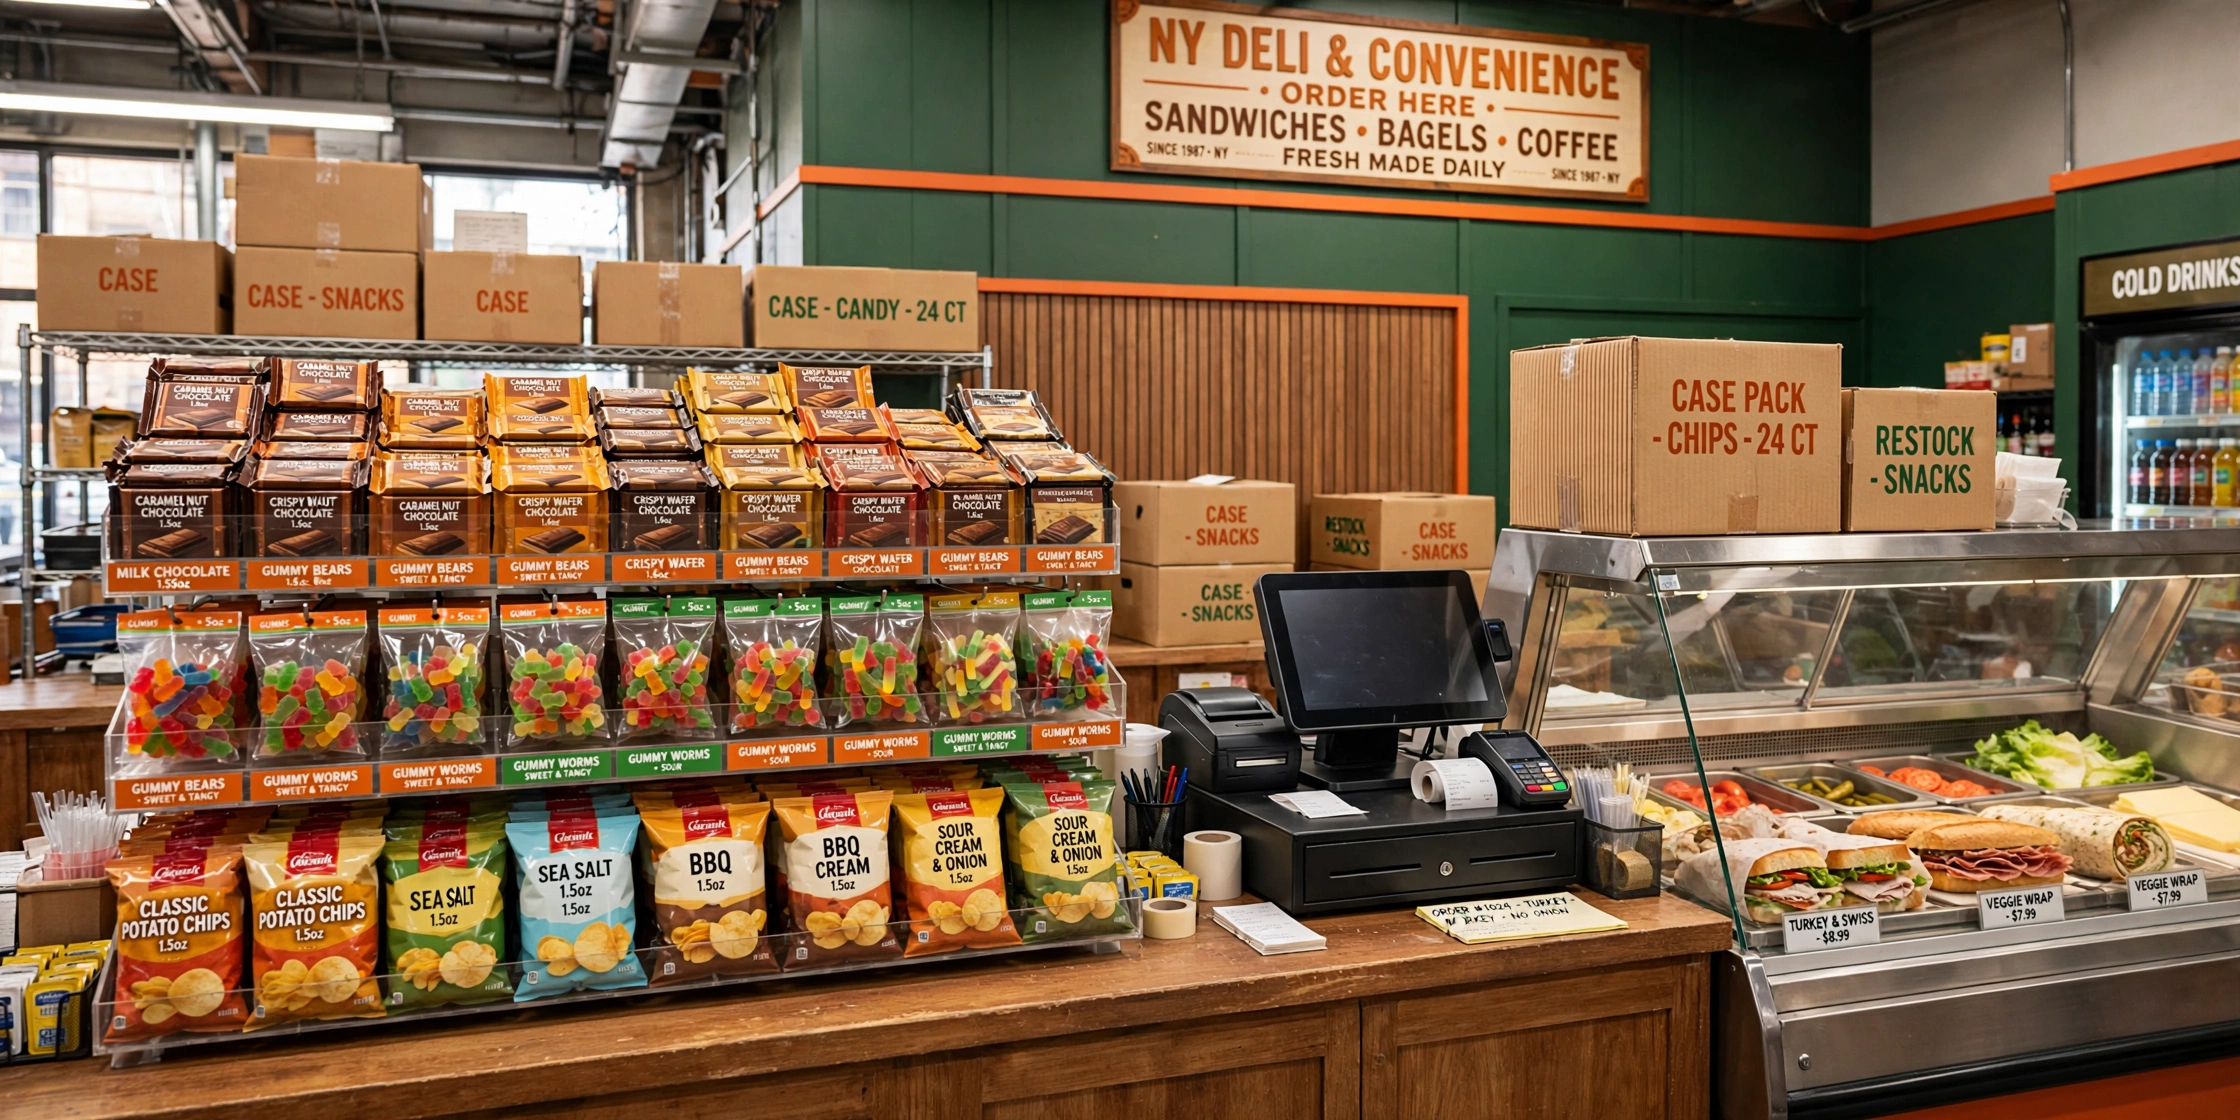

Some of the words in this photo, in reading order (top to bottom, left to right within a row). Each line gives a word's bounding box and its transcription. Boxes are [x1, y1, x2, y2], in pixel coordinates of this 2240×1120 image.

[1150, 17, 1204, 64] NY
[1223, 24, 1309, 73] DELI
[1326, 34, 1353, 77] &
[1369, 38, 1620, 100] CONVENIENCE
[1282, 82, 1387, 111] ORDER
[1399, 92, 1475, 117] HERE
[1145, 101, 1346, 144] SANDWICHES
[1378, 118, 1487, 153] BAGELS
[1517, 128, 1618, 161] COFFEE
[1147, 142, 1178, 157] SINCE
[1181, 144, 1204, 157] 1987
[1214, 146, 1228, 159] NY
[1283, 149, 1361, 171] FRESH
[1369, 154, 1434, 174] MADE
[1443, 158, 1505, 179] DAILY
[1552, 168, 1578, 182] SINCE
[1581, 170, 1600, 183] 1987
[1607, 172, 1619, 184] NY
[99, 268, 158, 293] CASE
[2112, 266, 2162, 299] COLD
[2168, 256, 2240, 293] DRINKS
[248, 283, 302, 308] CASE
[322, 287, 404, 311] SNACKS
[476, 290, 529, 313] CASE
[769, 295, 818, 319] CASE
[836, 298, 900, 320] CANDY
[916, 300, 938, 322] 24
[945, 301, 966, 322] CT
[1672, 379, 1736, 414] CASE
[1744, 381, 1806, 414] PACK
[1668, 422, 1738, 456] CHIPS
[1757, 424, 1785, 455] 24
[1791, 423, 1819, 456] CT
[1876, 425, 1975, 457] RESTOCK
[1884, 464, 1971, 495] SNACKS
[135, 496, 183, 507] CARAMEL
[186, 496, 208, 506] NUT
[270, 497, 304, 507] CRISPY
[400, 501, 440, 511] CARAMEL
[441, 501, 461, 510] NUT
[519, 497, 550, 507] CRISPY
[553, 497, 583, 506] WAFER
[634, 495, 665, 505] CRISPY
[667, 496, 695, 505] WAFER
[141, 507, 204, 518] CHOCOLATE
[274, 508, 333, 519] CHOCOLATE
[403, 511, 458, 521] CHOCOLATE
[525, 507, 577, 517] CHOCOLATE
[639, 505, 691, 515] CHOCOLATE
[1207, 505, 1247, 522] CASE
[1326, 516, 1365, 534] RESTOCK
[1419, 522, 1456, 539] CASE
[1196, 528, 1259, 546] SNACKS
[842, 554, 876, 565] CRISPY
[879, 554, 912, 564] WAFER
[1412, 543, 1468, 560] SNACKS
[390, 564, 433, 575] GUMMY
[437, 563, 474, 573] BEARS
[510, 561, 552, 572] GUMMY
[555, 560, 589, 571] BEARS
[625, 558, 666, 570] CRISPY
[669, 557, 705, 568] WAFER
[736, 556, 774, 567] GUMMY
[777, 556, 809, 566] BEARS
[117, 567, 150, 578] MILK
[154, 565, 230, 578] CHOCOLATE
[262, 565, 308, 577] GUMMY
[313, 564, 352, 575] BEARS
[1201, 584, 1243, 601] CASE
[575, 605, 592, 615] 5oz
[687, 602, 704, 611] 5oz
[794, 602, 810, 611] 5oz
[1192, 605, 1254, 622] SNACKS
[205, 616, 224, 626] 5oz
[333, 616, 351, 625] 5oz
[457, 612, 475, 621] 5oz
[1042, 726, 1076, 738] GUMMY
[1078, 724, 1111, 736] WORMS
[738, 745, 776, 757] GUMMY
[778, 742, 816, 754] WORMS
[844, 738, 881, 750] GUMMY
[884, 736, 919, 748] WORMS
[514, 759, 555, 772] GUMMY
[558, 755, 600, 769] WORMS
[628, 752, 668, 764] GUMMY
[671, 749, 711, 761] WORMS
[769, 756, 790, 765] SOUR
[263, 773, 308, 787] GUMMY
[313, 770, 358, 783] WORMS
[393, 766, 437, 779] GUMMY
[440, 763, 482, 776] WORMS
[525, 771, 552, 781] SWEET
[132, 781, 181, 795] GUMMY
[185, 778, 225, 792] BEARS
[404, 778, 434, 788] SWEET
[436, 777, 443, 785] &
[144, 794, 177, 805] SWEET
[179, 794, 186, 802] &
[276, 787, 307, 797] SWEET
[938, 822, 974, 840] SOUR
[1054, 815, 1088, 831] SOUR
[823, 835, 860, 859] BBQ
[935, 837, 983, 856] CREAM
[1052, 830, 1097, 848] CREAM
[1050, 850, 1060, 864] &
[1062, 844, 1102, 861] ONION
[538, 864, 570, 883] SEA
[575, 859, 612, 880] SALT
[689, 850, 732, 876] BBQ
[815, 856, 870, 879] CREAM
[932, 859, 942, 873] &
[945, 853, 988, 871] ONION
[1067, 863, 1089, 875] 1.5oz
[697, 879, 725, 892] 1.5oz
[831, 879, 855, 892] 1.5oz
[950, 873, 973, 885] 1.5oz
[2135, 877, 2169, 892] VEGGIE
[2172, 873, 2198, 889] WRAP
[276, 885, 343, 908] CLASSIC
[410, 890, 443, 911] SEA
[447, 885, 476, 909] SALT
[559, 883, 593, 899] 1.5oz
[139, 895, 209, 918] CLASSIC
[1986, 895, 2022, 909] VEGGIE
[2025, 891, 2054, 906] WRAP
[259, 906, 315, 930] POTATO
[318, 901, 366, 924] CHIPS
[562, 903, 591, 916] 1.5oz
[1432, 907, 1469, 917] ORDER
[1511, 911, 1529, 920] NO
[1534, 908, 1569, 917] ONION
[2011, 907, 2037, 922] $7.99
[122, 916, 179, 940] POTATO
[182, 912, 231, 934] CHIPS
[430, 914, 458, 927] 1.5oz
[1789, 916, 1829, 932] TURKEY
[1831, 915, 1839, 927] &
[1842, 911, 1874, 926] SWISS
[295, 928, 324, 942] 1.5oz
[1822, 929, 1850, 945] $8.99
[158, 938, 188, 953] 1.5oz
